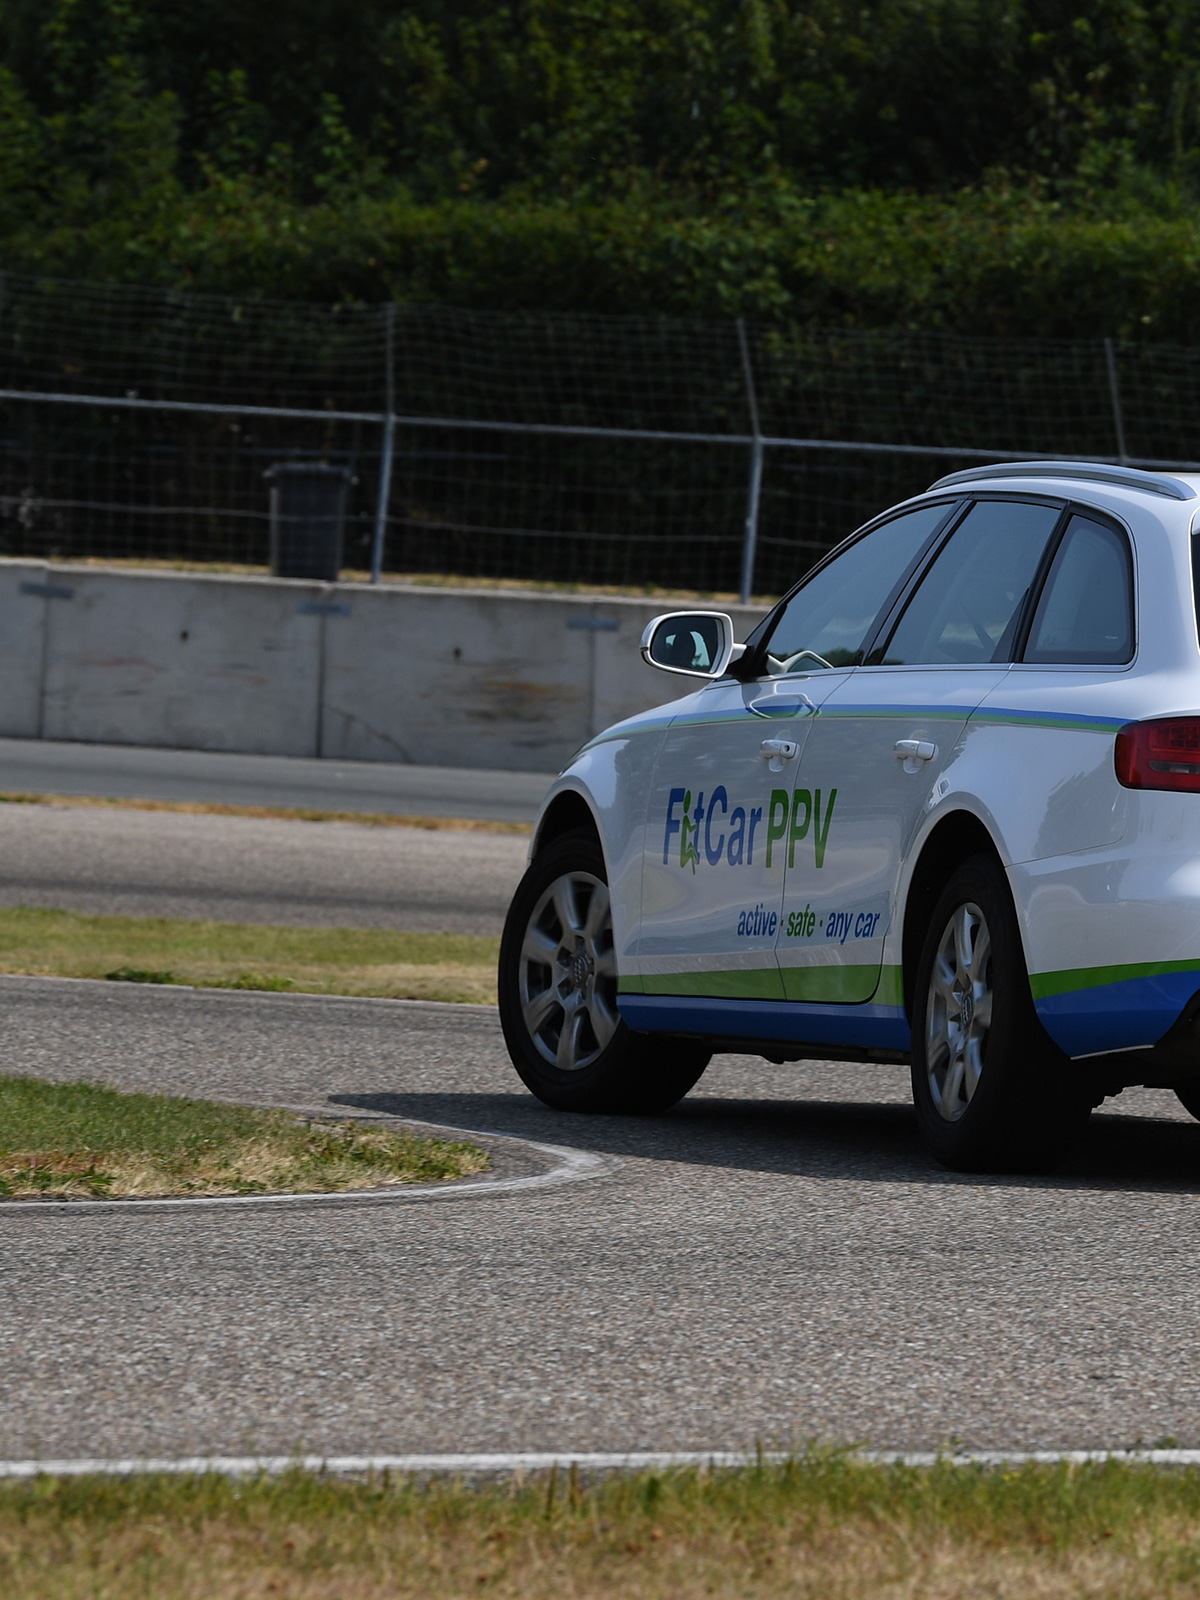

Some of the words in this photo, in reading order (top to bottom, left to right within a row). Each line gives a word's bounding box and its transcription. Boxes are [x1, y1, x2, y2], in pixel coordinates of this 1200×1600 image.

[766, 788, 838, 868] PPV
[737, 903, 777, 936] active
[787, 904, 816, 937] safe
[826, 912, 854, 945] any
[855, 912, 880, 938] car
